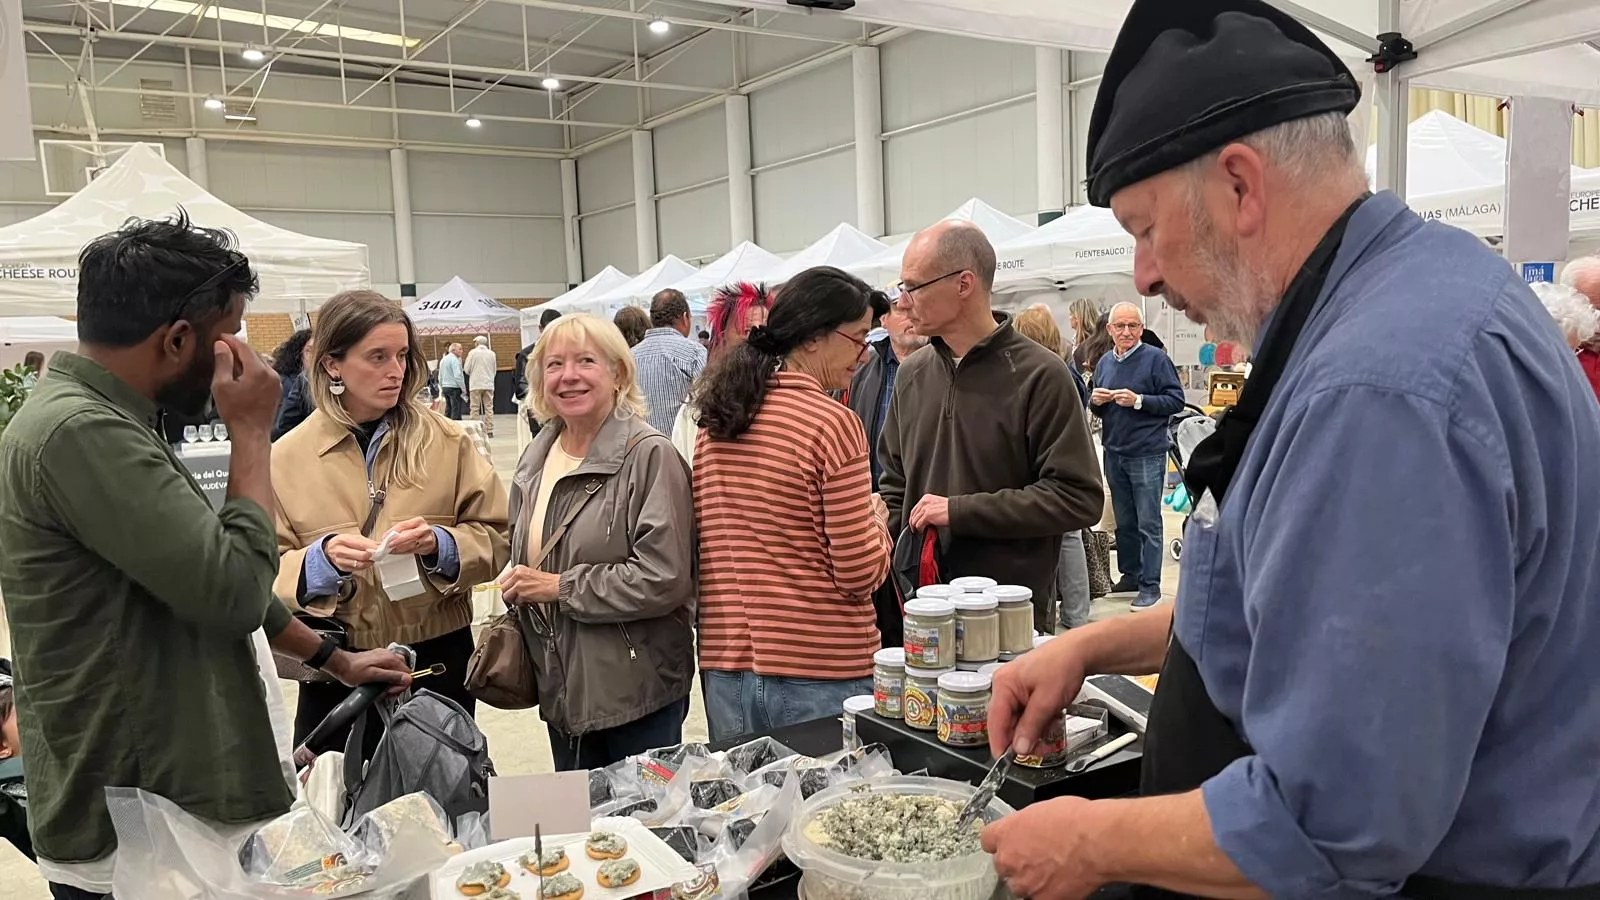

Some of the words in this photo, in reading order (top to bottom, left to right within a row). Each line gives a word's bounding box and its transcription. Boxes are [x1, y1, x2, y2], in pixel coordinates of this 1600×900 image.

[1569, 197, 1600, 212] CHE
[1445, 203, 1501, 220] (MÁLAGA)
[1075, 247, 1125, 258] FUENTESAUCO
[1003, 259, 1024, 269] ROUTE
[418, 300, 462, 310] 3404
[203, 470, 215, 479] del
